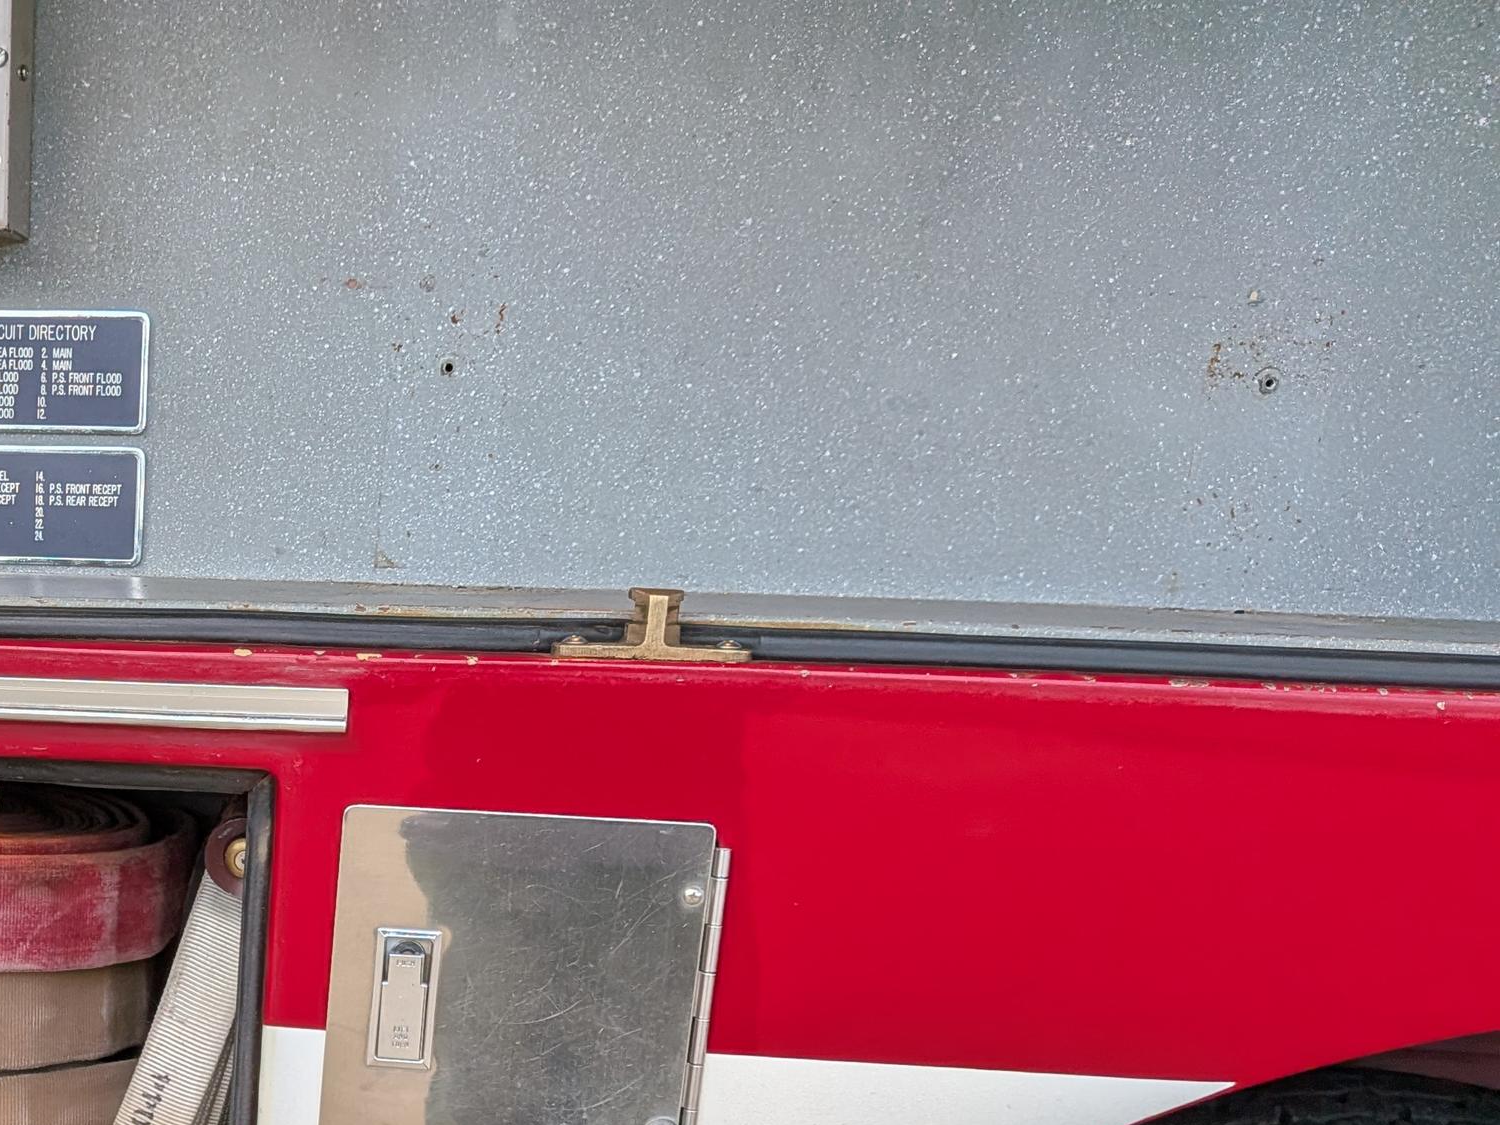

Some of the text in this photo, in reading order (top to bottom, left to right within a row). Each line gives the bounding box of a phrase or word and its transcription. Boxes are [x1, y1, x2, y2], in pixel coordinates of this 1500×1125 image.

[29, 324, 97, 341] DIRECTORY
[9, 347, 33, 358] FLOOD
[52, 347, 72, 359] MAIN
[9, 359, 33, 370] FLOOD
[52, 360, 72, 371] MAIN
[52, 372, 66, 383] P.S.
[68, 372, 94, 384] FRONT
[96, 373, 122, 384] FLOOD
[51, 384, 66, 395] P.S.
[68, 385, 94, 396] FRONT
[96, 385, 121, 396] FLOOD
[49, 483, 63, 494] P.S.
[65, 483, 91, 494] FRONT
[92, 484, 122, 495] RECEPT
[49, 495, 64, 506] P.S.
[66, 495, 86, 506] REAR
[88, 496, 119, 507] RECEPT
